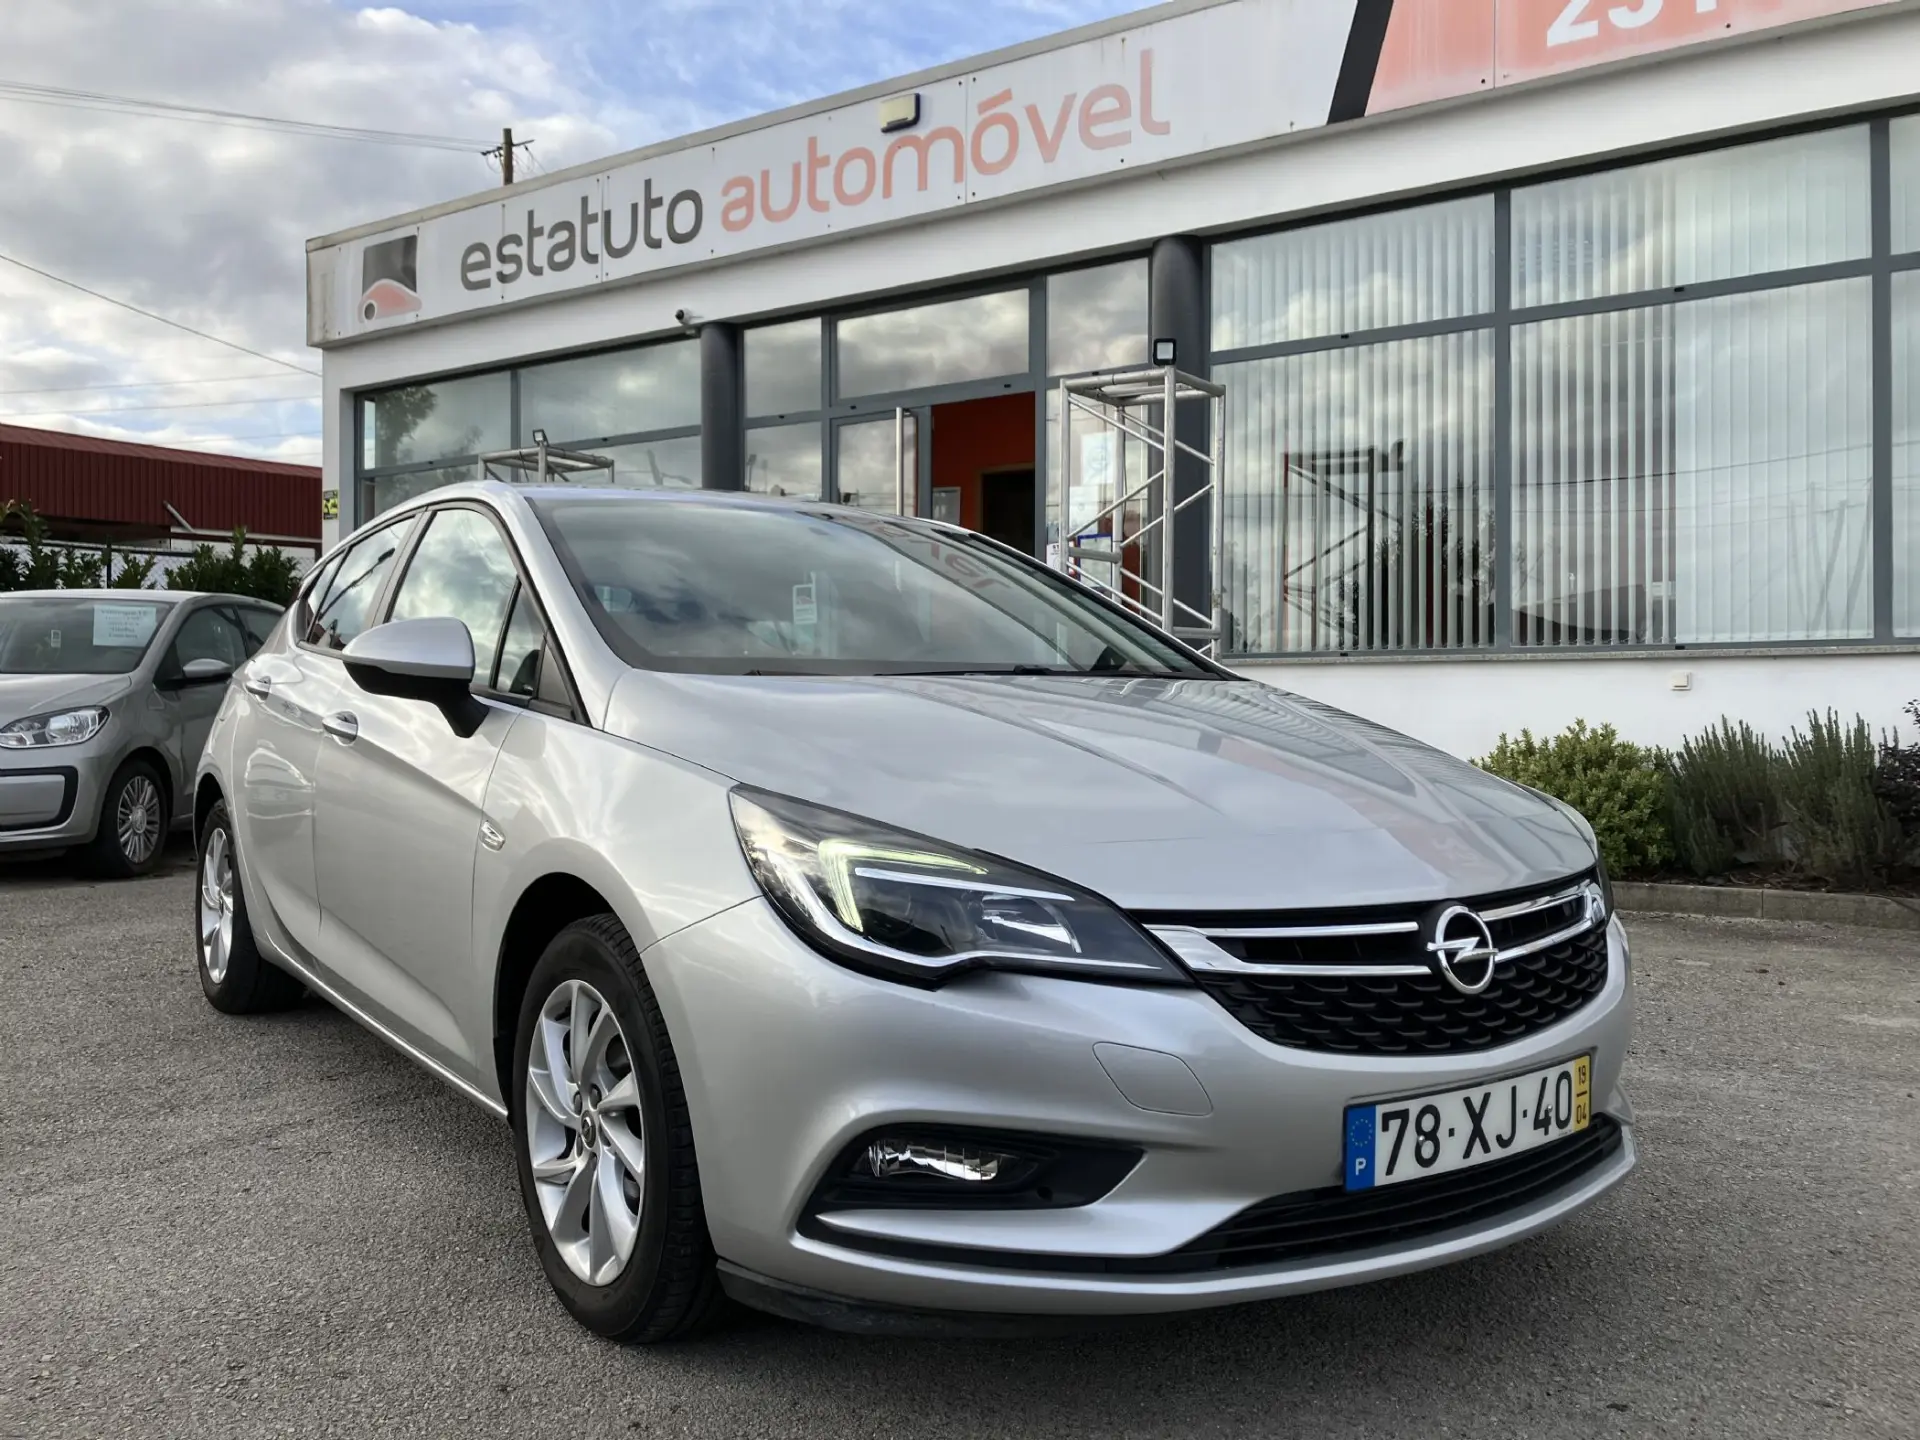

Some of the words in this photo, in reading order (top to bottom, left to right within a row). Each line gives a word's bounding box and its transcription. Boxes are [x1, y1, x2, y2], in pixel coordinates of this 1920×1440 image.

[461, 178, 703, 291] estatuto
[720, 48, 1171, 232] automóvel
[1578, 1065, 1587, 1085] 19
[1576, 1102, 1587, 1125] 04
[1355, 1158, 1367, 1176] P
